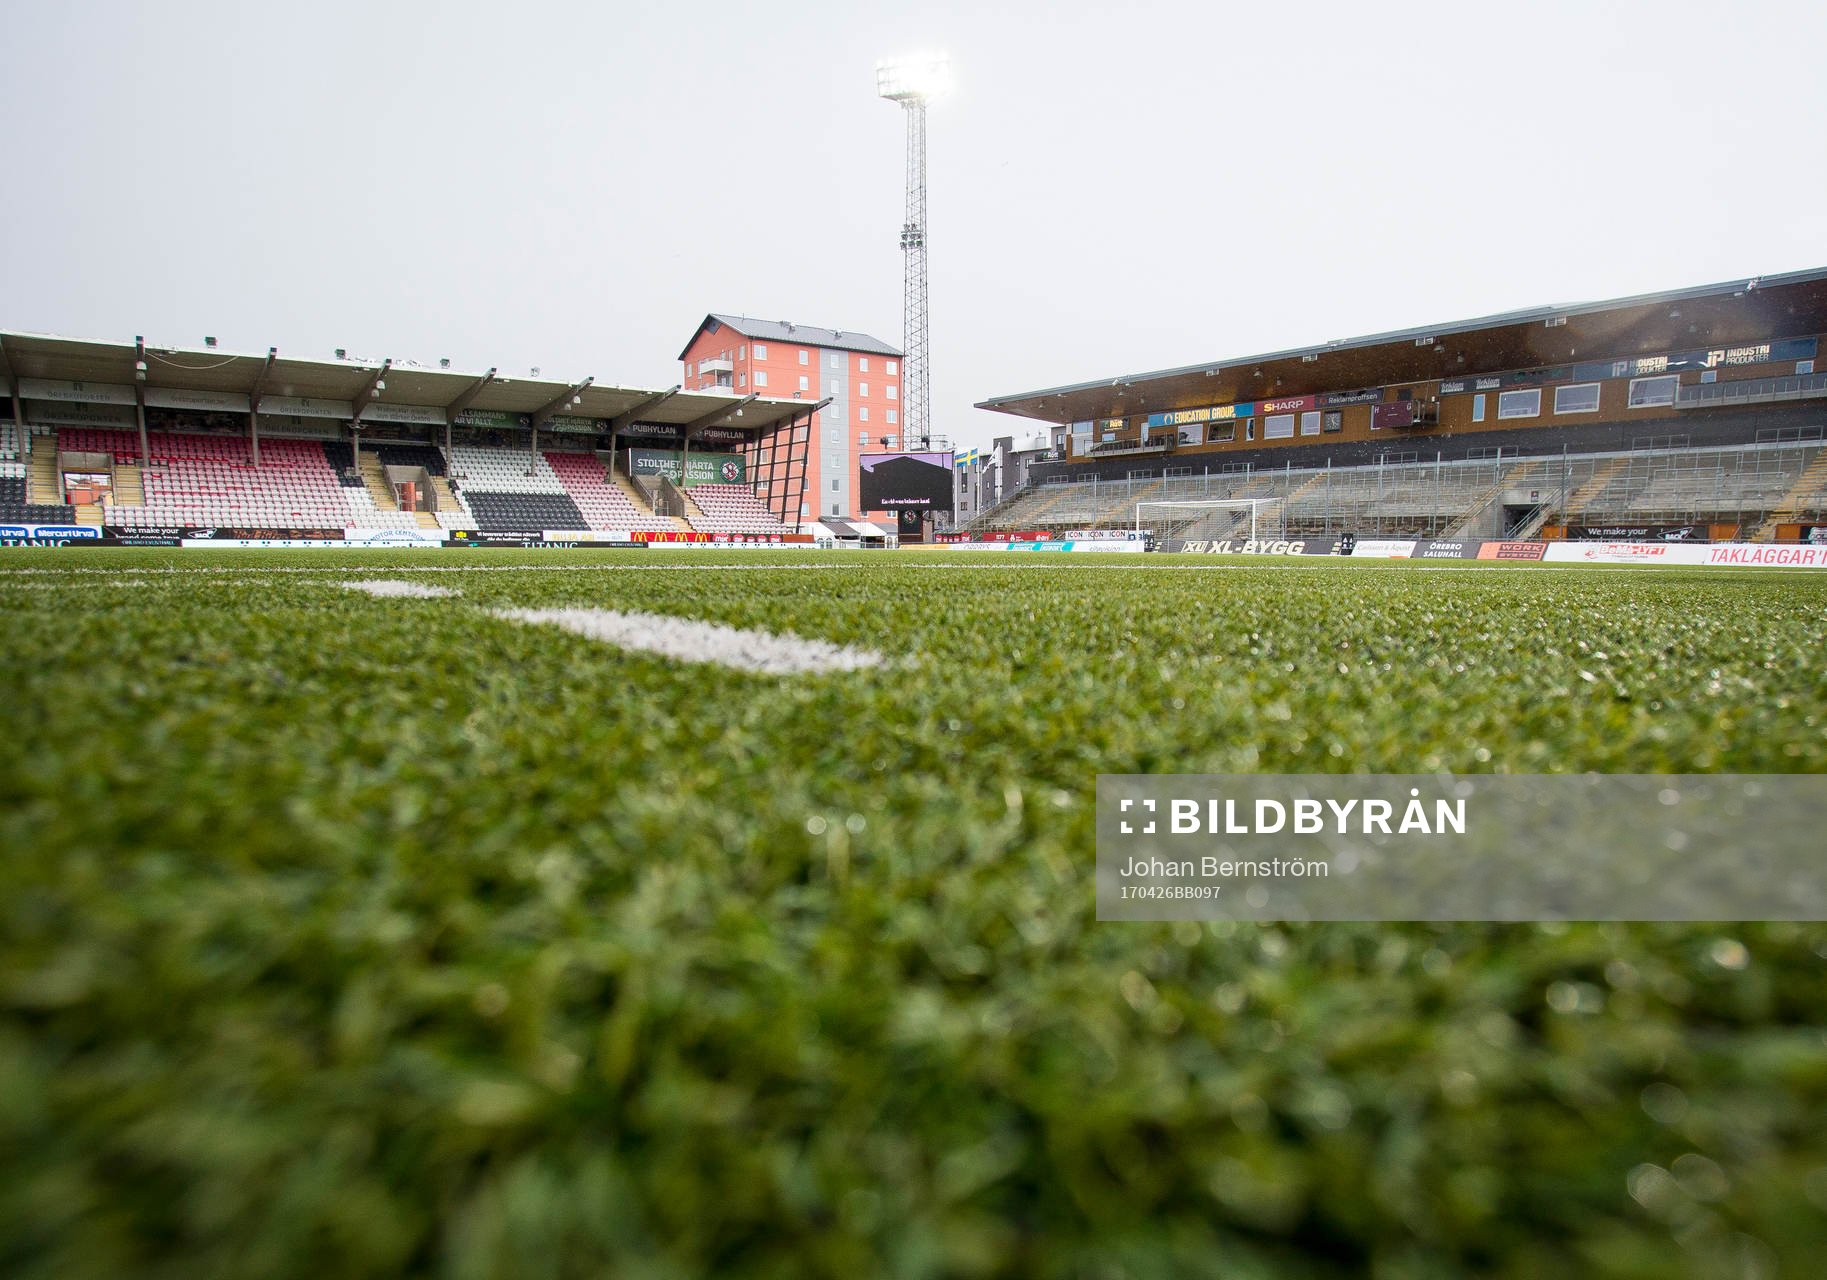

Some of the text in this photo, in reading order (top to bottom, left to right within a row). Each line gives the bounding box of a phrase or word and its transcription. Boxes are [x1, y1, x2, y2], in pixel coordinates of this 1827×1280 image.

[1727, 345, 1770, 357] INDUSTRI
[1727, 354, 1769, 365] PRODUKTER
[1328, 393, 1378, 404] Reklamproffsen
[1264, 400, 1303, 413] SHARP
[1174, 409, 1210, 423] EDUCATION
[633, 424, 676, 434] PUBHYLLAN
[704, 429, 744, 439] PUBHYLLAN
[2, 529, 26, 537] Urval
[1588, 527, 1648, 538] We make your
[1208, 541, 1305, 555] XL-BYGG
[1429, 542, 1463, 551] ÖREBRO
[1502, 544, 1542, 552] WORK
[1423, 550, 1462, 558] SALUHALL
